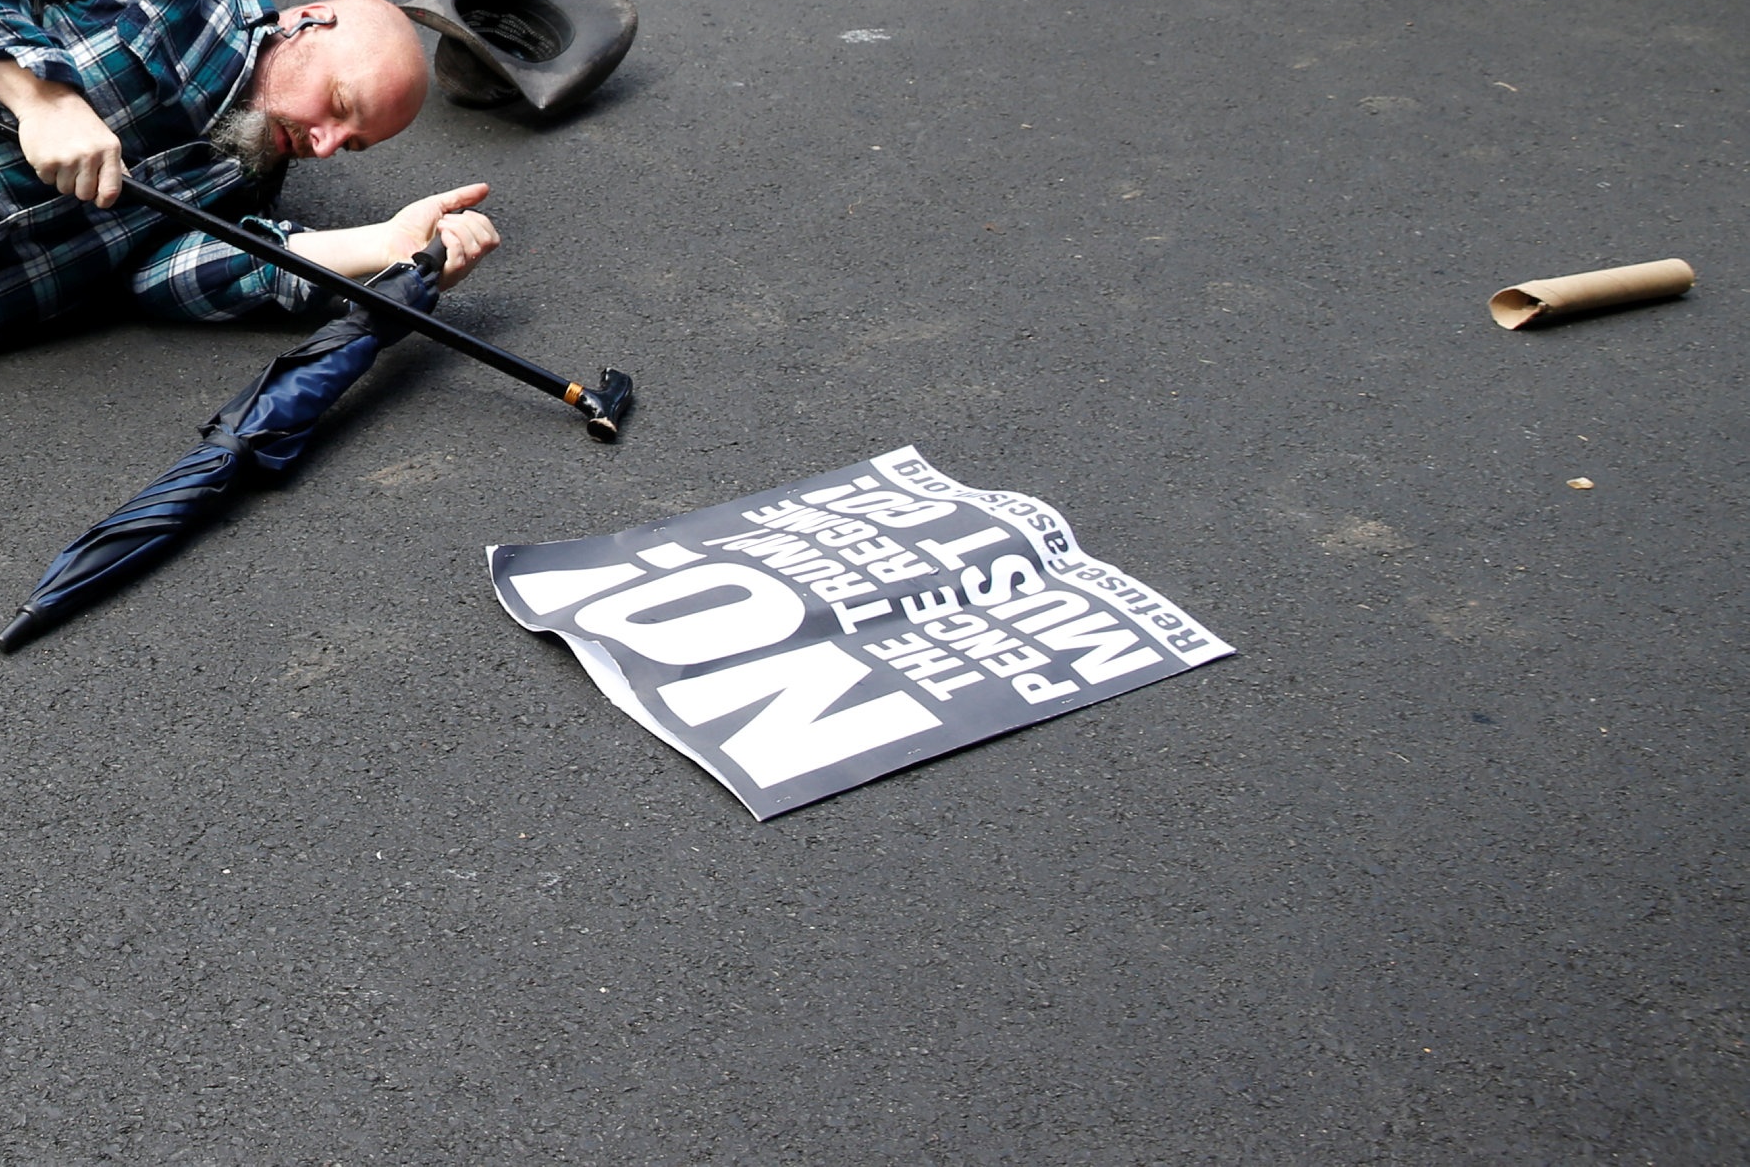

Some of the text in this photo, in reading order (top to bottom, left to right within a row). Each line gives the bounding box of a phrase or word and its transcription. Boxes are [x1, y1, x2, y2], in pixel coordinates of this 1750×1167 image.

[509, 541, 944, 789] NO!
[702, 527, 986, 702] THE TRUMP/
[741, 498, 1082, 706] PENCE REGIME
[800, 474, 1164, 685] MUST GO!
